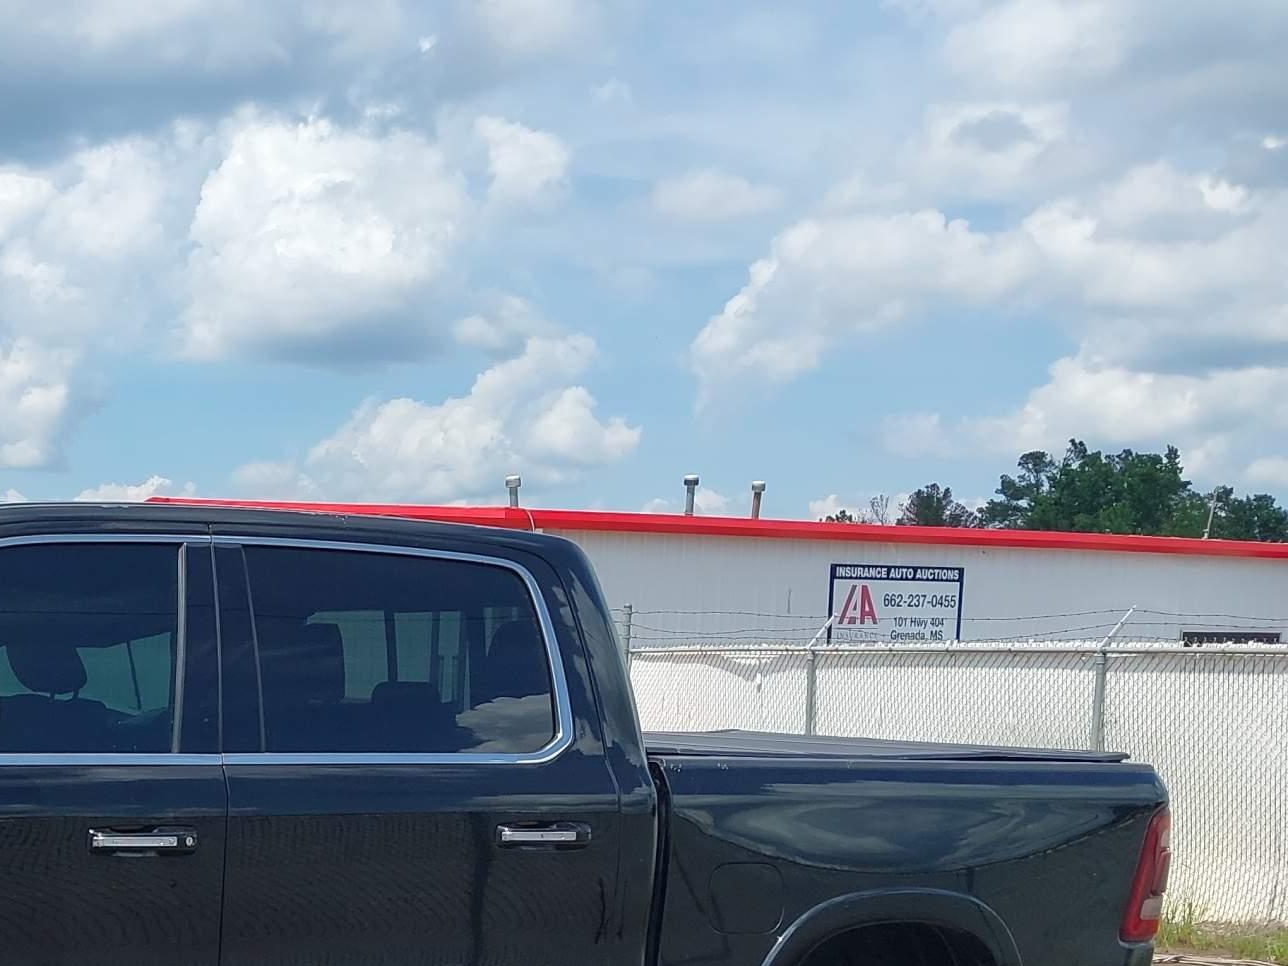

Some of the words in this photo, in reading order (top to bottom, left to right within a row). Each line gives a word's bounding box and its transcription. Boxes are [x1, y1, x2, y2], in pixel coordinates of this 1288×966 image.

[836, 566, 887, 578] INSURANCE
[889, 568, 914, 579] AUTO
[915, 569, 960, 580] AUCTIONS
[883, 593, 956, 608] 662-237-0455
[894, 617, 908, 627] 101
[910, 617, 929, 629] Hwy
[930, 617, 944, 627] 404
[930, 630, 943, 640] MS
